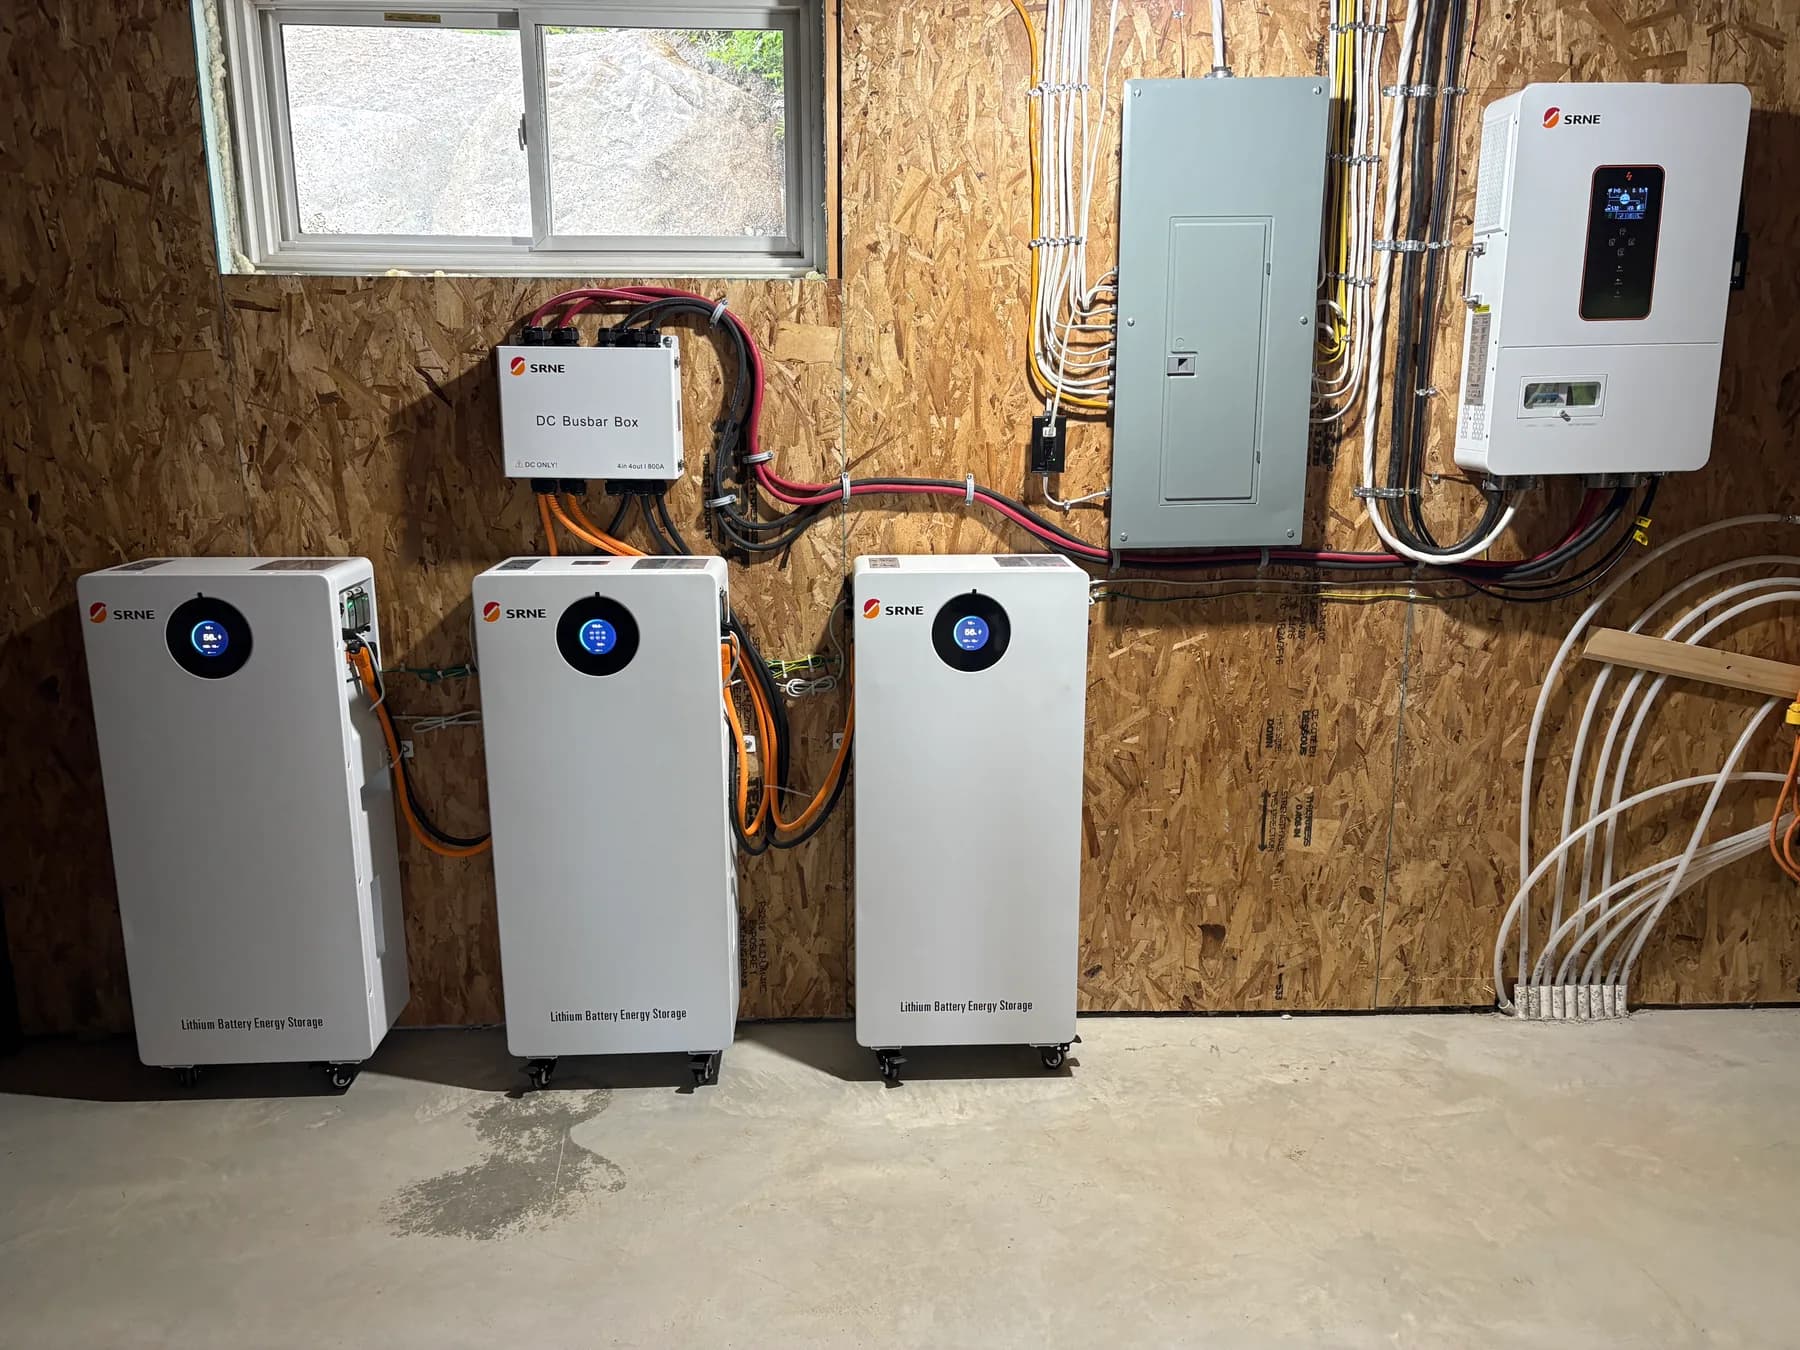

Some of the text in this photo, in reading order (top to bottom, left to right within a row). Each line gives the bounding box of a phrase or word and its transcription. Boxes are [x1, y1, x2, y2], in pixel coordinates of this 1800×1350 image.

[1563, 113, 1601, 125] SRNE
[530, 364, 565, 374] SRNE
[536, 415, 638, 428] DC Busbar Box
[536, 461, 558, 469] ONLY!
[113, 609, 155, 621] SRNE
[506, 608, 547, 619] SRNE
[885, 605, 924, 616] SRNE
[1266, 719, 1275, 748] DOWN
[900, 1000, 1033, 1014] Lithium Battery Energy Storage
[550, 1008, 687, 1023] Lithium Battery Energy Storage
[181, 1016, 323, 1031] Lithium Battery Energy Storage
